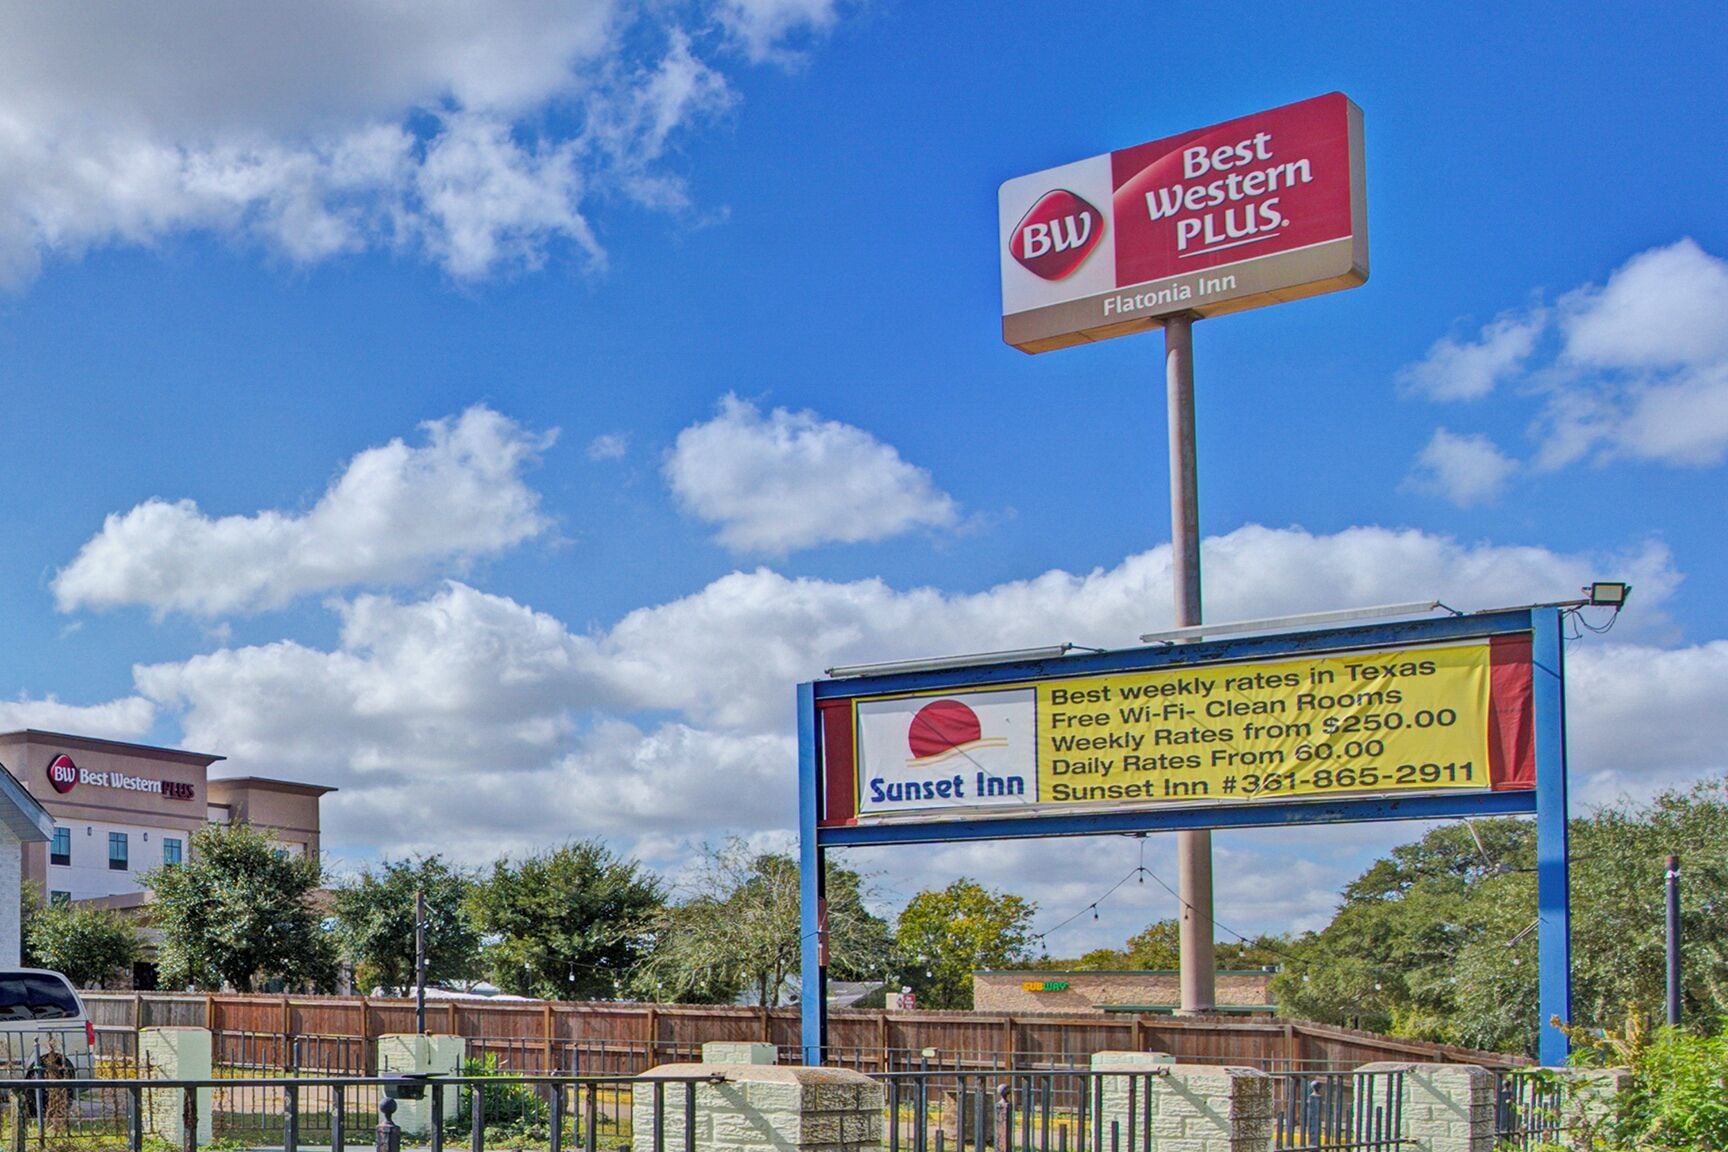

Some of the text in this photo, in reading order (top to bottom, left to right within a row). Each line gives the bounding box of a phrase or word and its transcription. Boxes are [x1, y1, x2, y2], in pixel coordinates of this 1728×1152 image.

[1183, 132, 1273, 180] Best
[1144, 157, 1313, 221] Western
[1022, 210, 1093, 260] BW
[1103, 275, 1236, 316] Flatonia Inn
[1051, 660, 1436, 706] Best weekly rates in Texas
[1052, 712, 1110, 729] Free
[1206, 699, 1286, 718] Clean
[1297, 689, 1403, 712] Rooms
[1051, 708, 1457, 752] Weekly Rates from $250.00
[55, 766, 75, 782] BW
[1052, 739, 1384, 777] Daily Rates From 60.00
[79, 768, 195, 799] Best Western PLUS
[870, 771, 1025, 803] Sunset Inn
[1052, 761, 1473, 801] Sunset Inn #361-865-2911
[1023, 980, 1070, 992] SUBWAY
